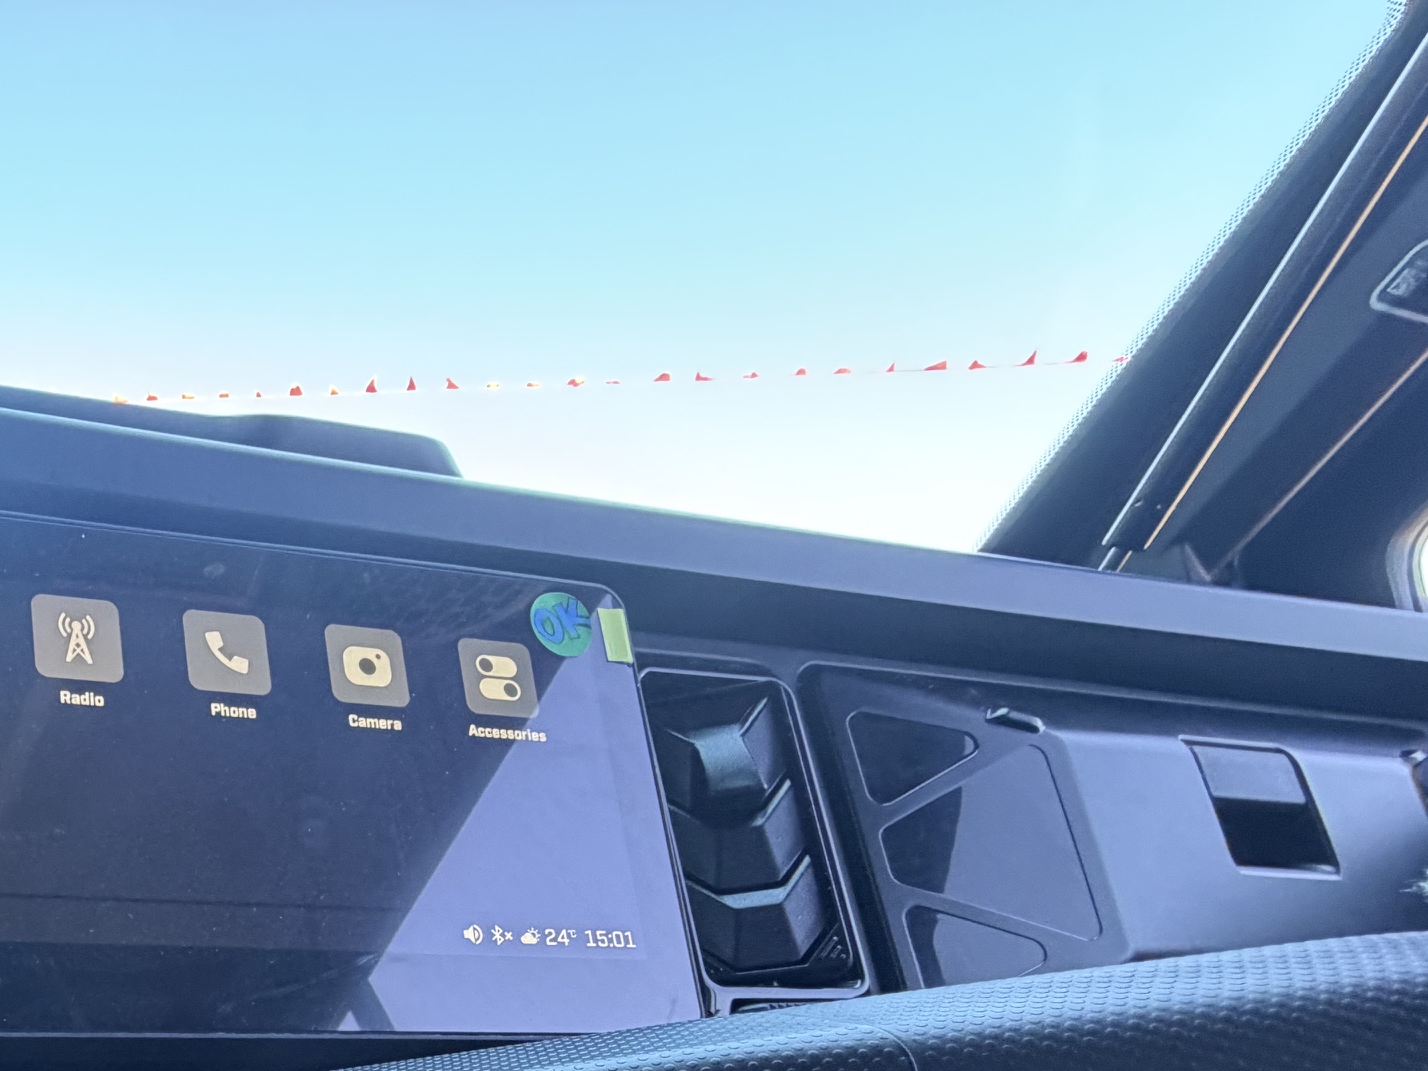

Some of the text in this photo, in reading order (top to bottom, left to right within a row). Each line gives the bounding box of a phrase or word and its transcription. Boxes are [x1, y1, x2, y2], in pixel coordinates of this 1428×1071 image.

[534, 597, 592, 644] OK
[59, 690, 105, 708] Radio
[211, 702, 257, 720] Phone
[348, 714, 402, 732] Camera
[469, 724, 547, 743] Accessories
[585, 930, 637, 948] 15:01
